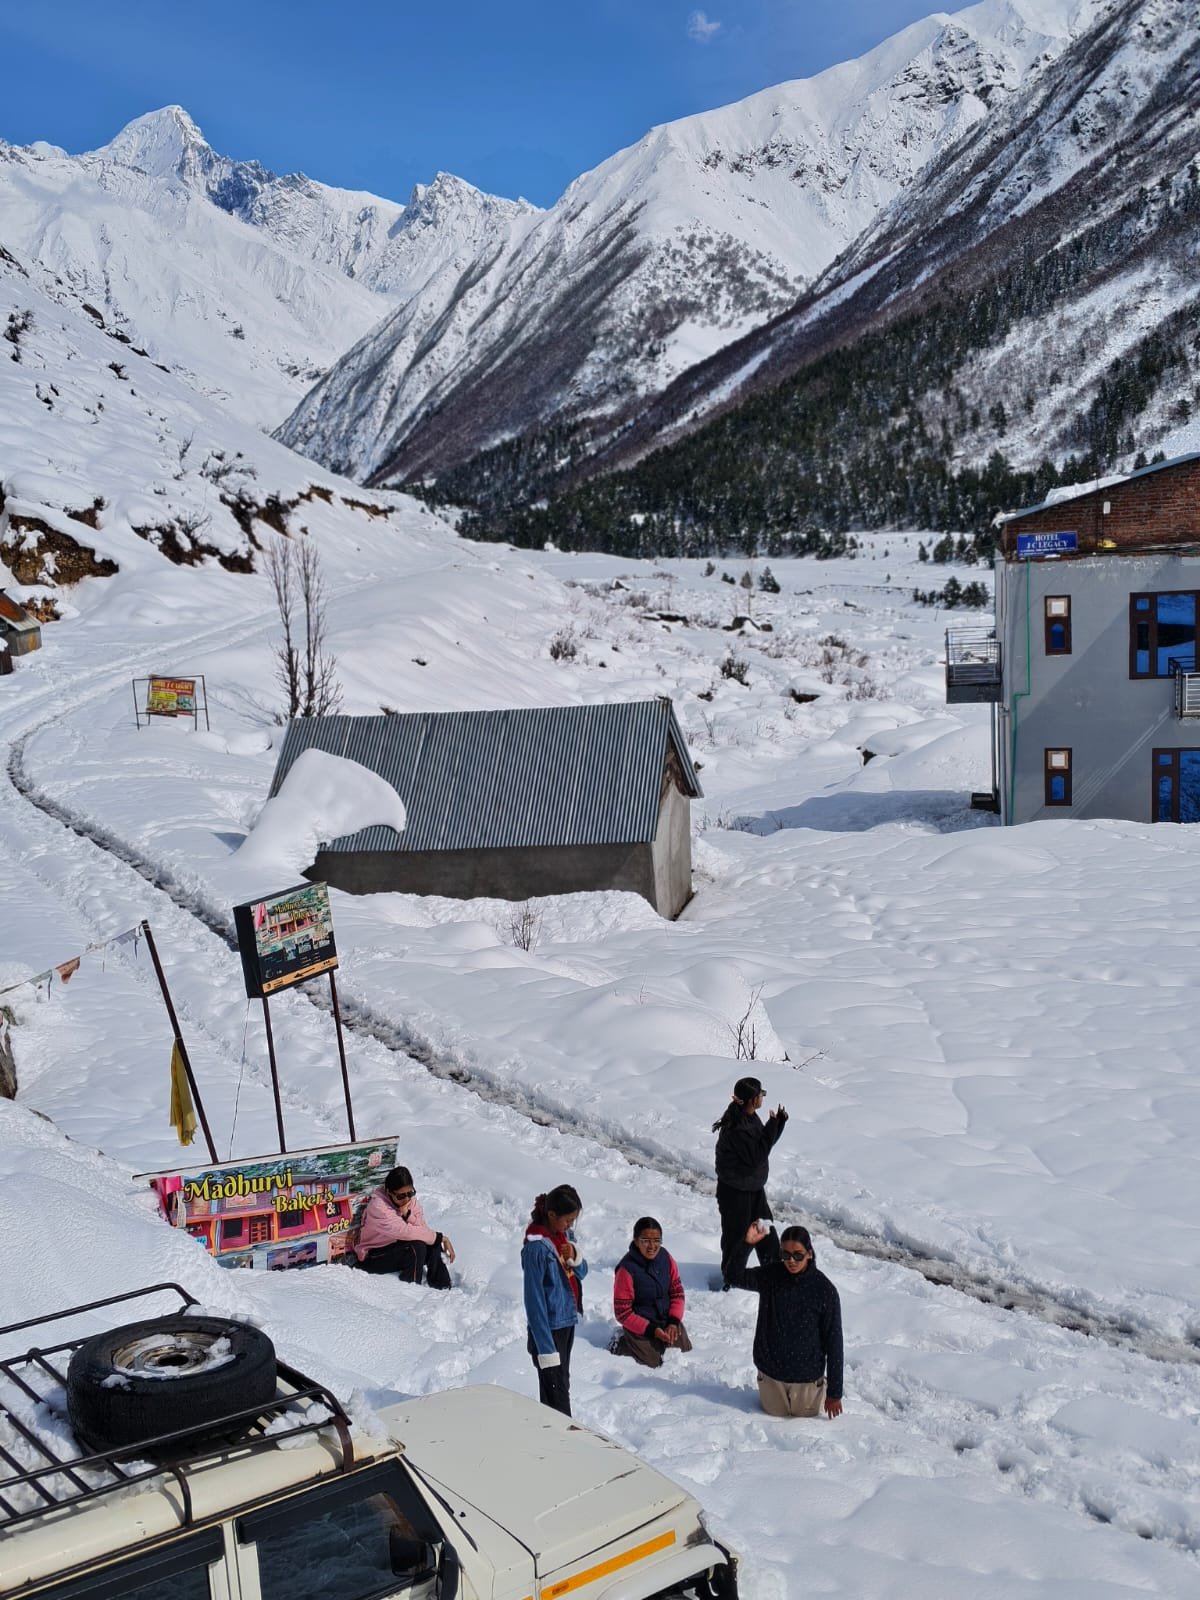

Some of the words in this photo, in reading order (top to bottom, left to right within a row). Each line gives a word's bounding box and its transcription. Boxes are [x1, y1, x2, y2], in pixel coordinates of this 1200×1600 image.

[1038, 540, 1068, 549] LEGACY
[183, 1167, 293, 1202] Madhurvi
[271, 1190, 334, 1213] Baker's
[327, 1217, 350, 1235] cafe
